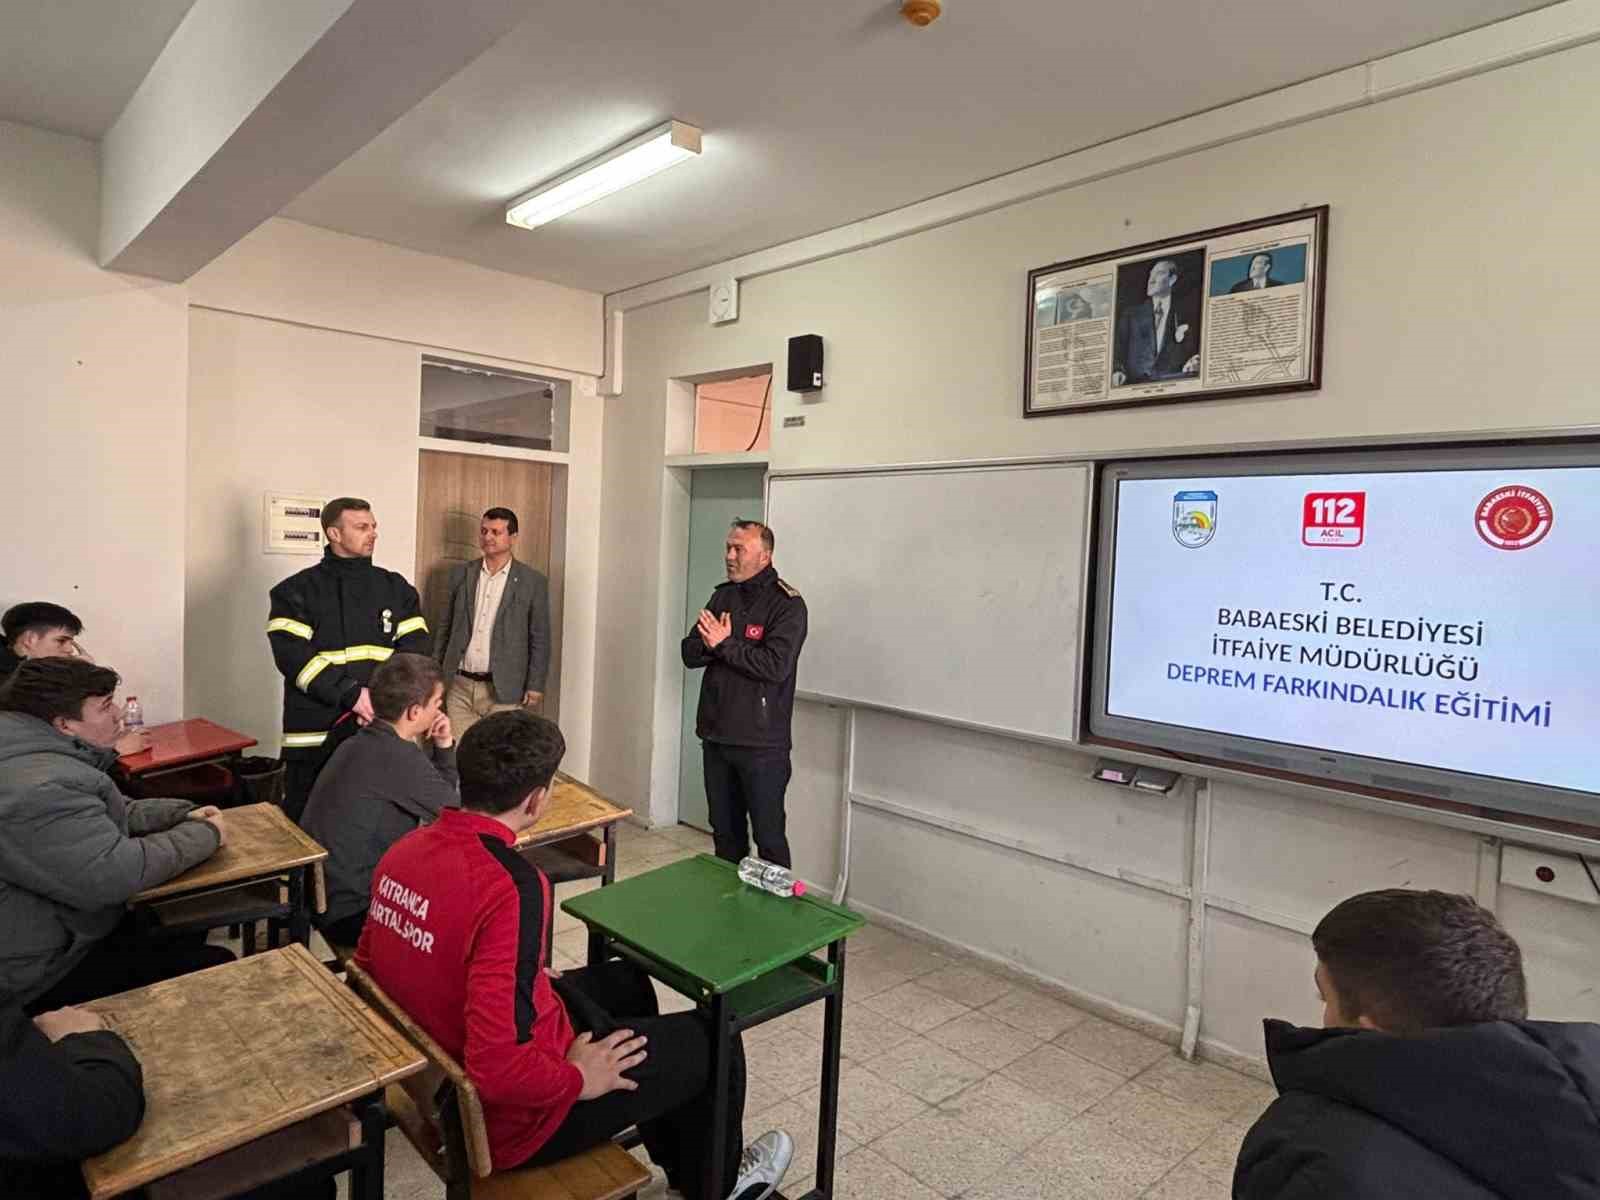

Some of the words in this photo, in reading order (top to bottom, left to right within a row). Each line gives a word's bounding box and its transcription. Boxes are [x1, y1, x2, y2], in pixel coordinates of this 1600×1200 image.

[1312, 498, 1356, 524] 112
[1320, 582, 1362, 603] T.C.
[1218, 608, 1329, 634] BABAESKİ
[1336, 616, 1484, 647] BELEDİYESİ
[1212, 633, 1293, 663] İTFAİYE
[1300, 643, 1479, 682] MÜDÜRLÜĞÜ
[1167, 662, 1256, 691] DEPREM
[1263, 673, 1427, 712] FARKINDALIK
[1435, 690, 1552, 728] EĞİTİMİ
